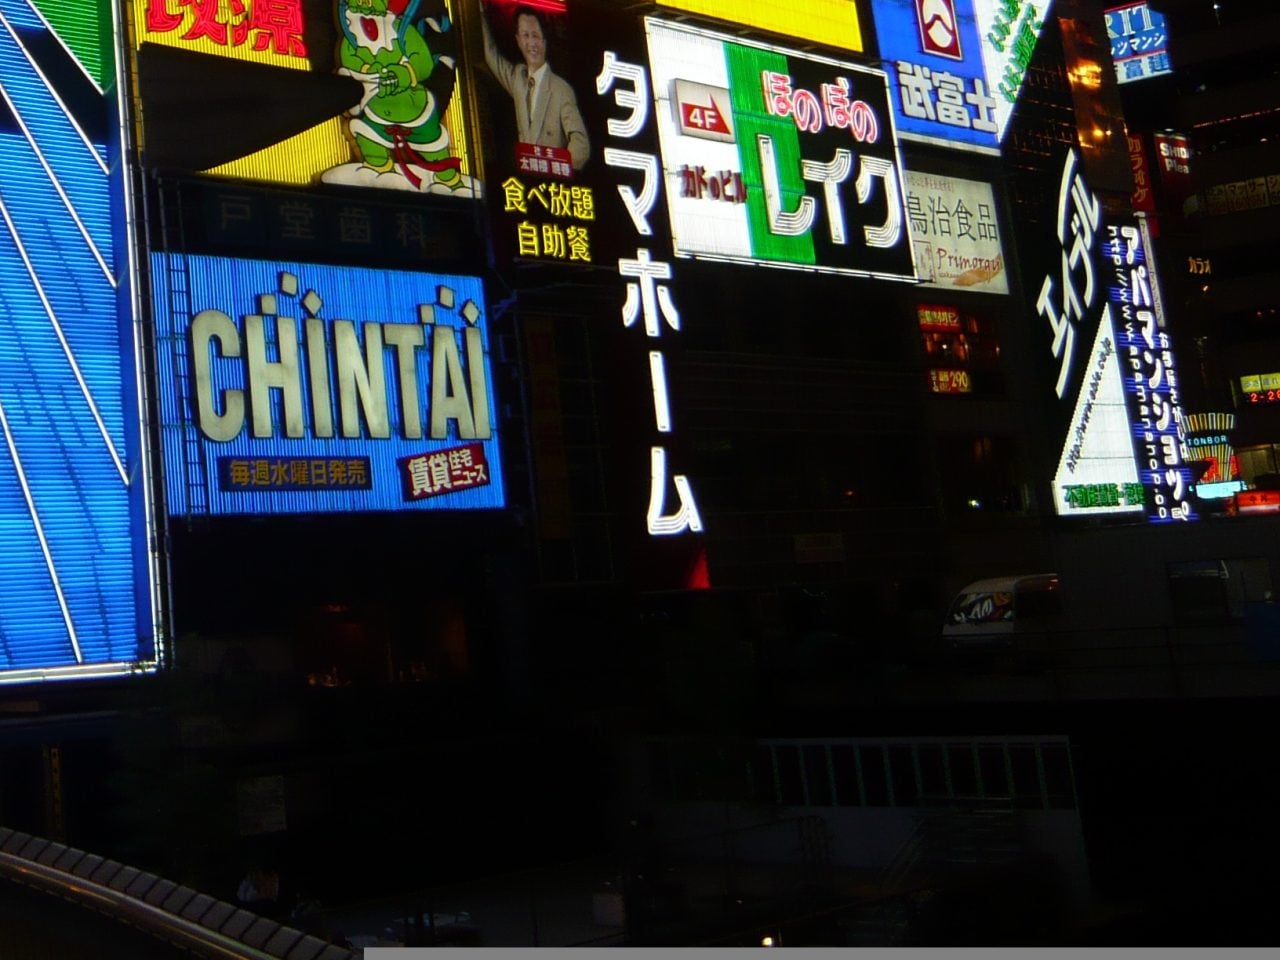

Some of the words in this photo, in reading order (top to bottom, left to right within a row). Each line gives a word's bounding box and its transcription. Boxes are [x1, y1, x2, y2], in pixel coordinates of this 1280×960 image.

[689, 107, 718, 129] 4F
[761, 69, 879, 144] ほのぼの
[896, 60, 998, 134] 武富士
[502, 177, 595, 220] 食べ放題
[756, 133, 903, 249] レイク
[517, 220, 592, 262] 自助餐
[595, 50, 705, 536] タマホーム
[190, 271, 493, 442] CHINTAI
[229, 459, 367, 487] 毎週水曜日発売
[450, 463, 488, 487] ニュース
